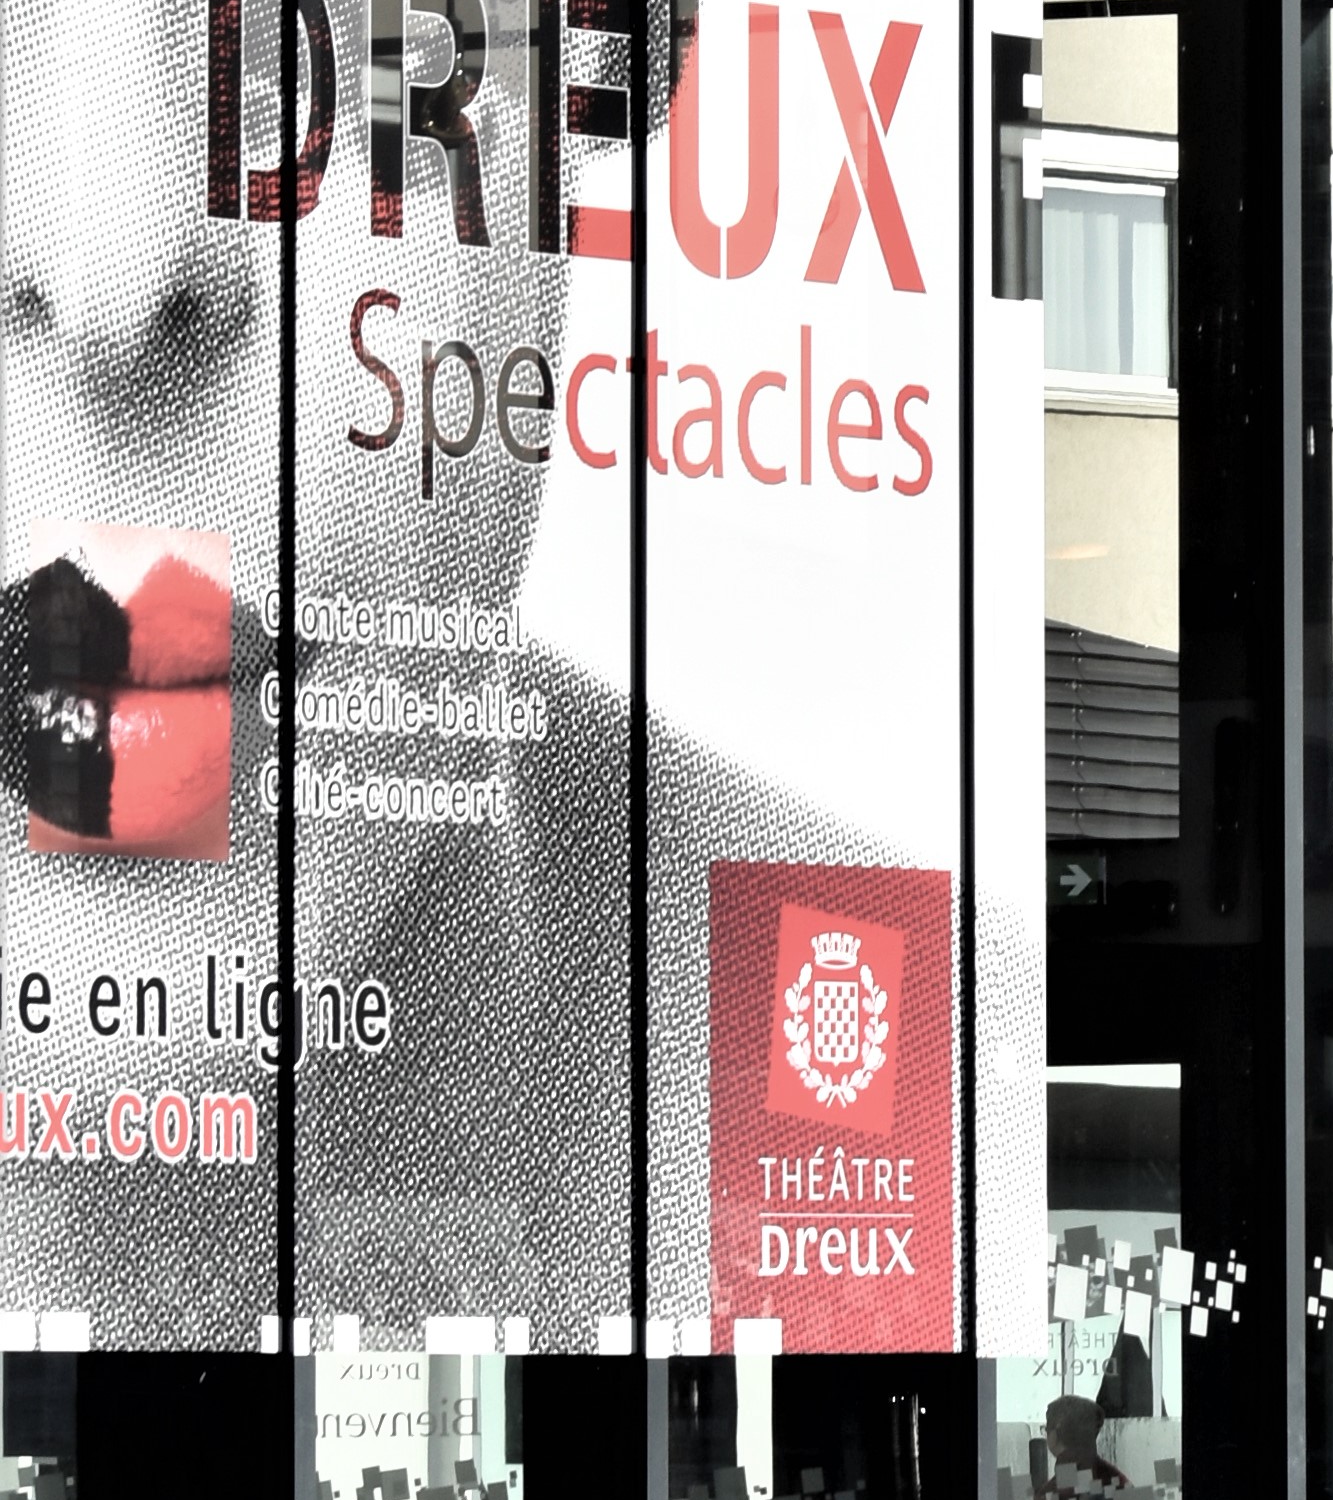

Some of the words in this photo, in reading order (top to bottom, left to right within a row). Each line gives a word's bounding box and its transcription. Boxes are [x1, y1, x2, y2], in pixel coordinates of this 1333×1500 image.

[346, 288, 932, 500] Spectacles
[390, 600, 523, 648] musical
[89, 974, 167, 1037] en
[206, 954, 388, 1066] ligne
[758, 1145, 915, 1202] THÉÂTRE
[758, 1225, 915, 1277] Dreux
